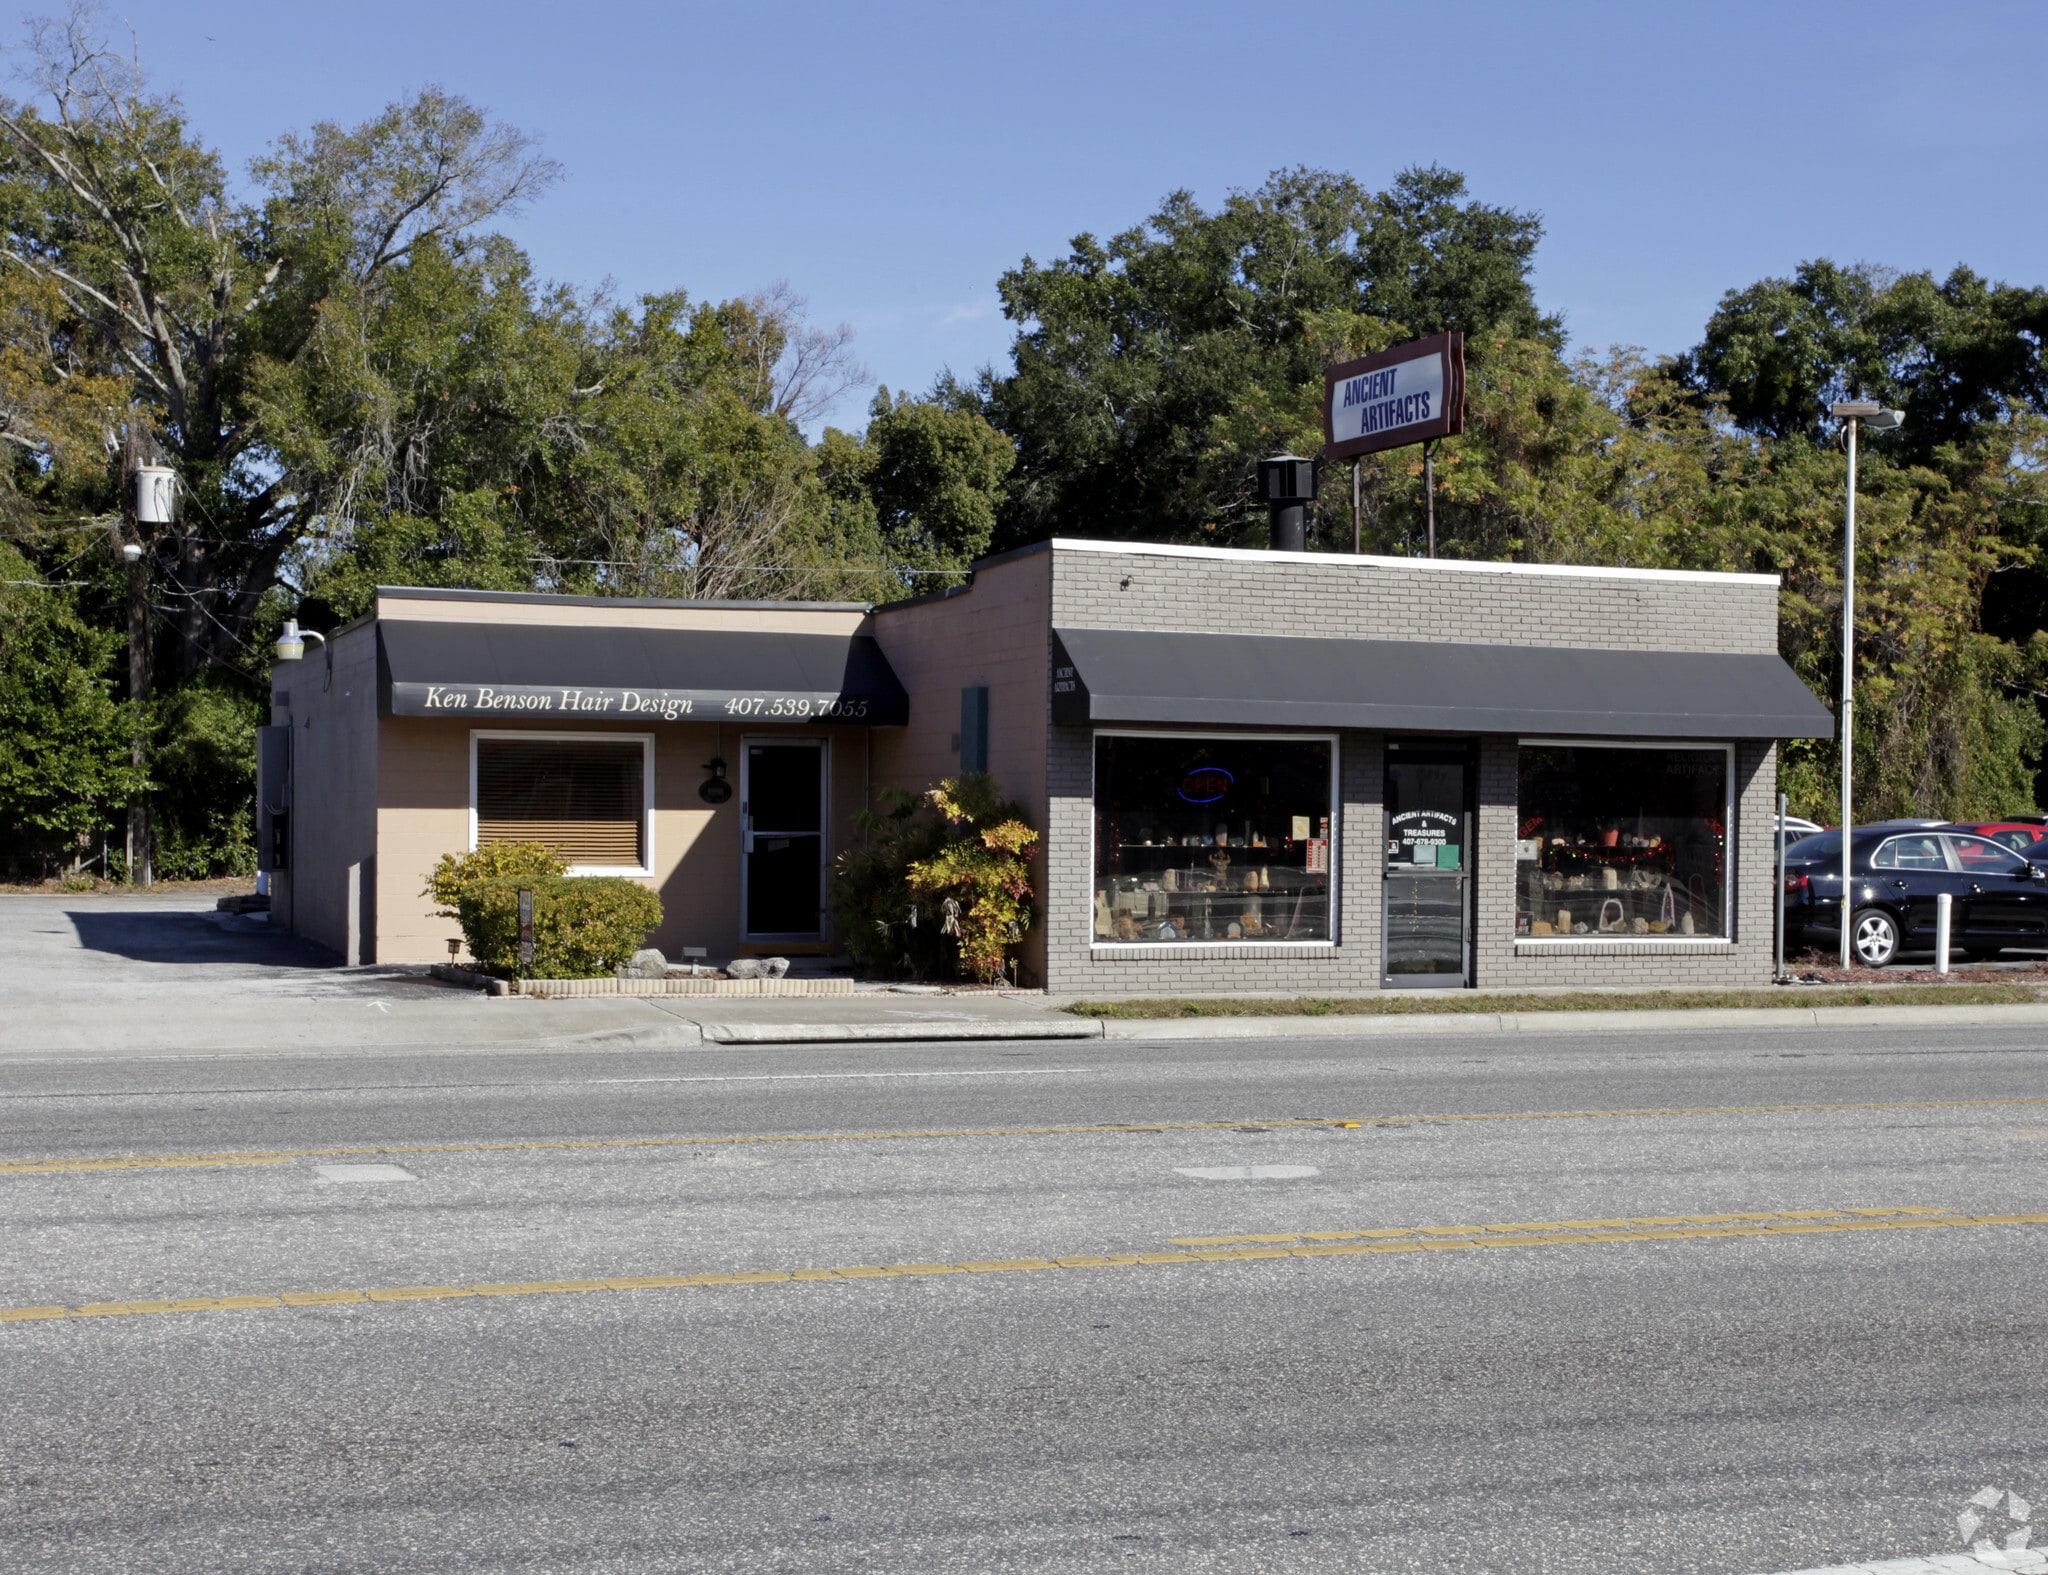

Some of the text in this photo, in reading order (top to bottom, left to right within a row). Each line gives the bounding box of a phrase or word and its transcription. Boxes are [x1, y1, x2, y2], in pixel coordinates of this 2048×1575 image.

[1344, 368, 1397, 408] ANCIENT
[1361, 391, 1430, 434] ARTIFACTS
[424, 687, 867, 720] Ken Benson Hair Design 407.539.7055
[1183, 777, 1227, 792] OPEN
[1392, 810, 1457, 826] ANCIENT ARTIFACTS
[1421, 820, 1427, 828] &
[1403, 829, 1446, 837] TREASURES
